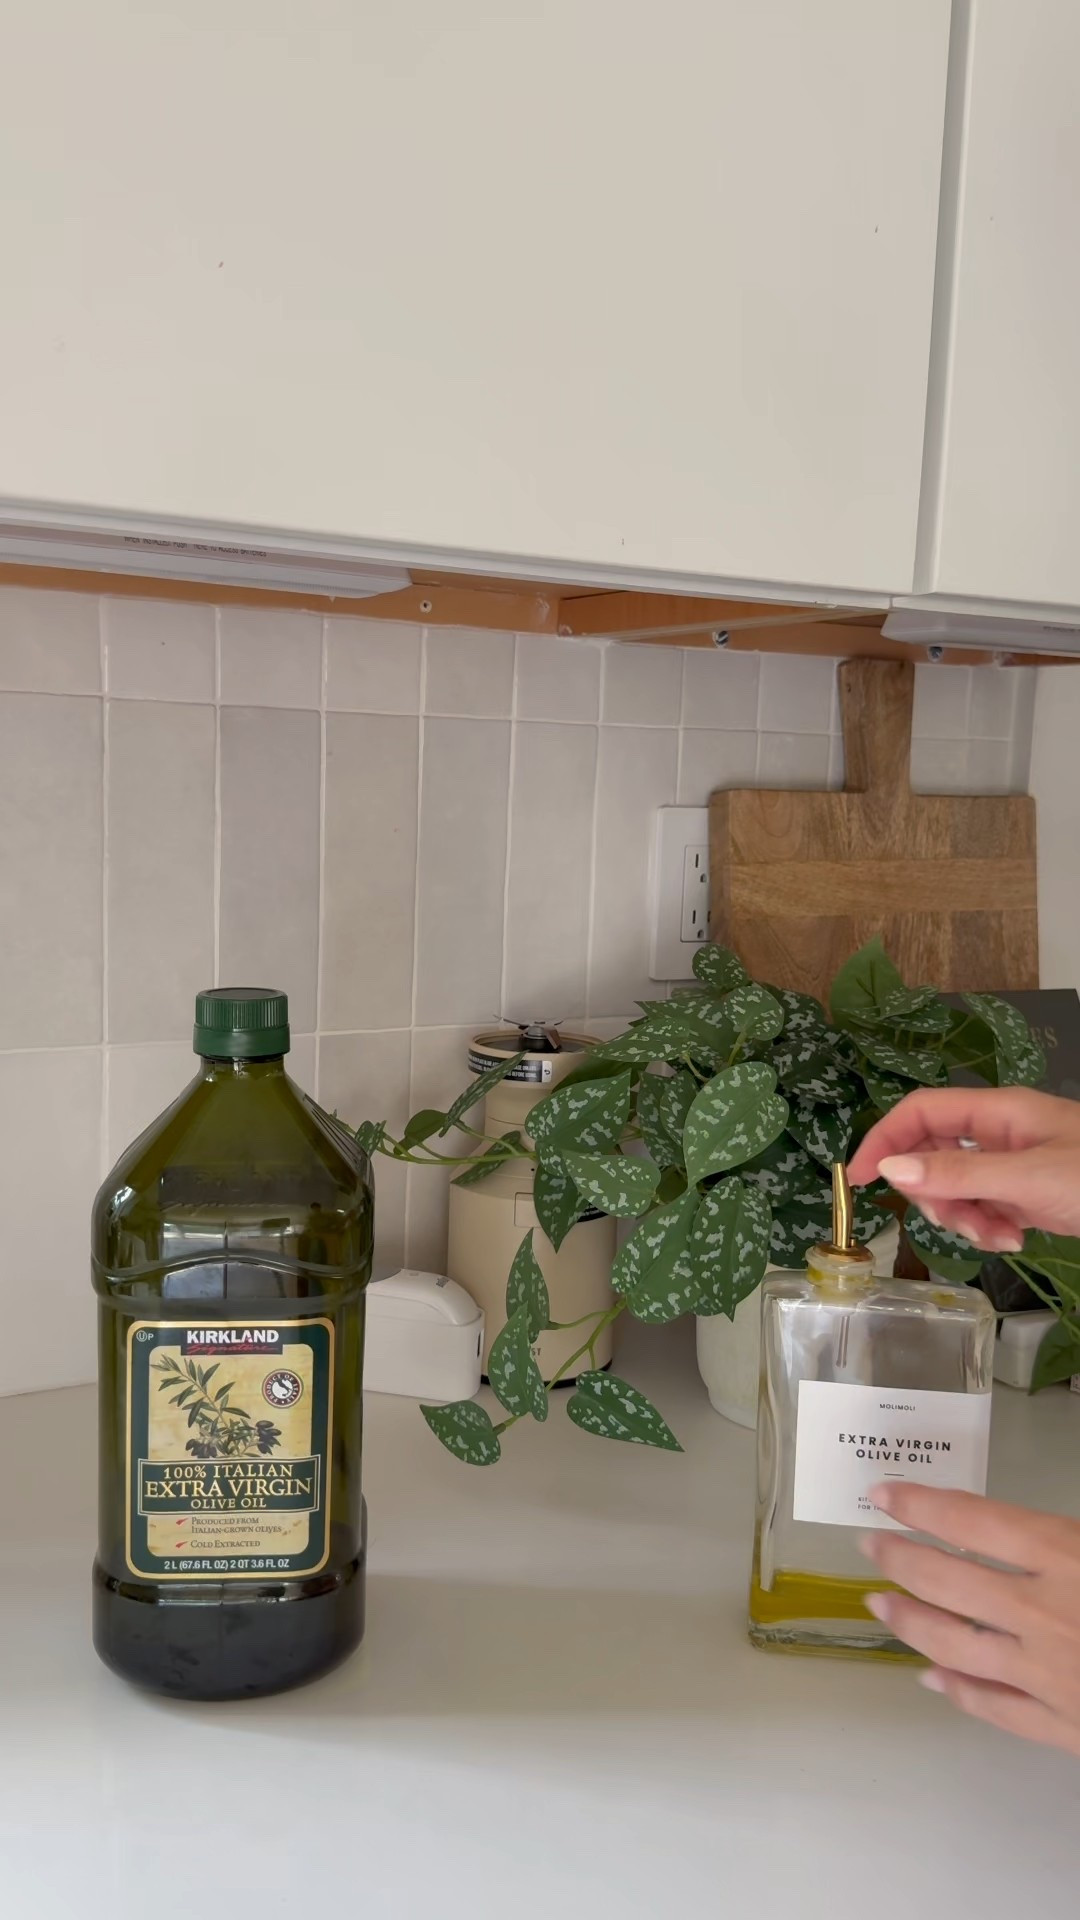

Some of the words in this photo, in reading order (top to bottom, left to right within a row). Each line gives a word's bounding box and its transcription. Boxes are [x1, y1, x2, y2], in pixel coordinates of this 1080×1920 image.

[187, 1329, 279, 1344] KIRKLAND
[879, 1403, 916, 1411] MOLIMOLI
[838, 1433, 888, 1447] EXTRA
[895, 1438, 951, 1452] VIRGIN
[856, 1448, 901, 1462] OLIVE
[908, 1453, 932, 1464] OIL
[163, 1465, 207, 1480] 100%
[213, 1464, 294, 1478] ITALIAN
[144, 1480, 224, 1498] EXTRA
[230, 1477, 313, 1497] VIRGIN
[190, 1498, 236, 1509] OLIVE
[240, 1497, 267, 1508] OIL
[191, 1517, 235, 1525] PRODUCED
[191, 1526, 254, 1534] ITALIAN-GROWN
[255, 1525, 282, 1533] OLIVES
[190, 1539, 213, 1548] COLD
[214, 1539, 261, 1548] EXTRACTED
[164, 1560, 170, 1570] 2
[171, 1560, 178, 1570] L
[179, 1559, 202, 1570] (67.6
[202, 1559, 213, 1569] FL
[213, 1559, 229, 1570] OZ)
[230, 1560, 236, 1569] 2
[237, 1559, 250, 1569] QT
[251, 1559, 264, 1568] 3.6
[266, 1559, 277, 1568] FL
[277, 1558, 290, 1568] OZ
